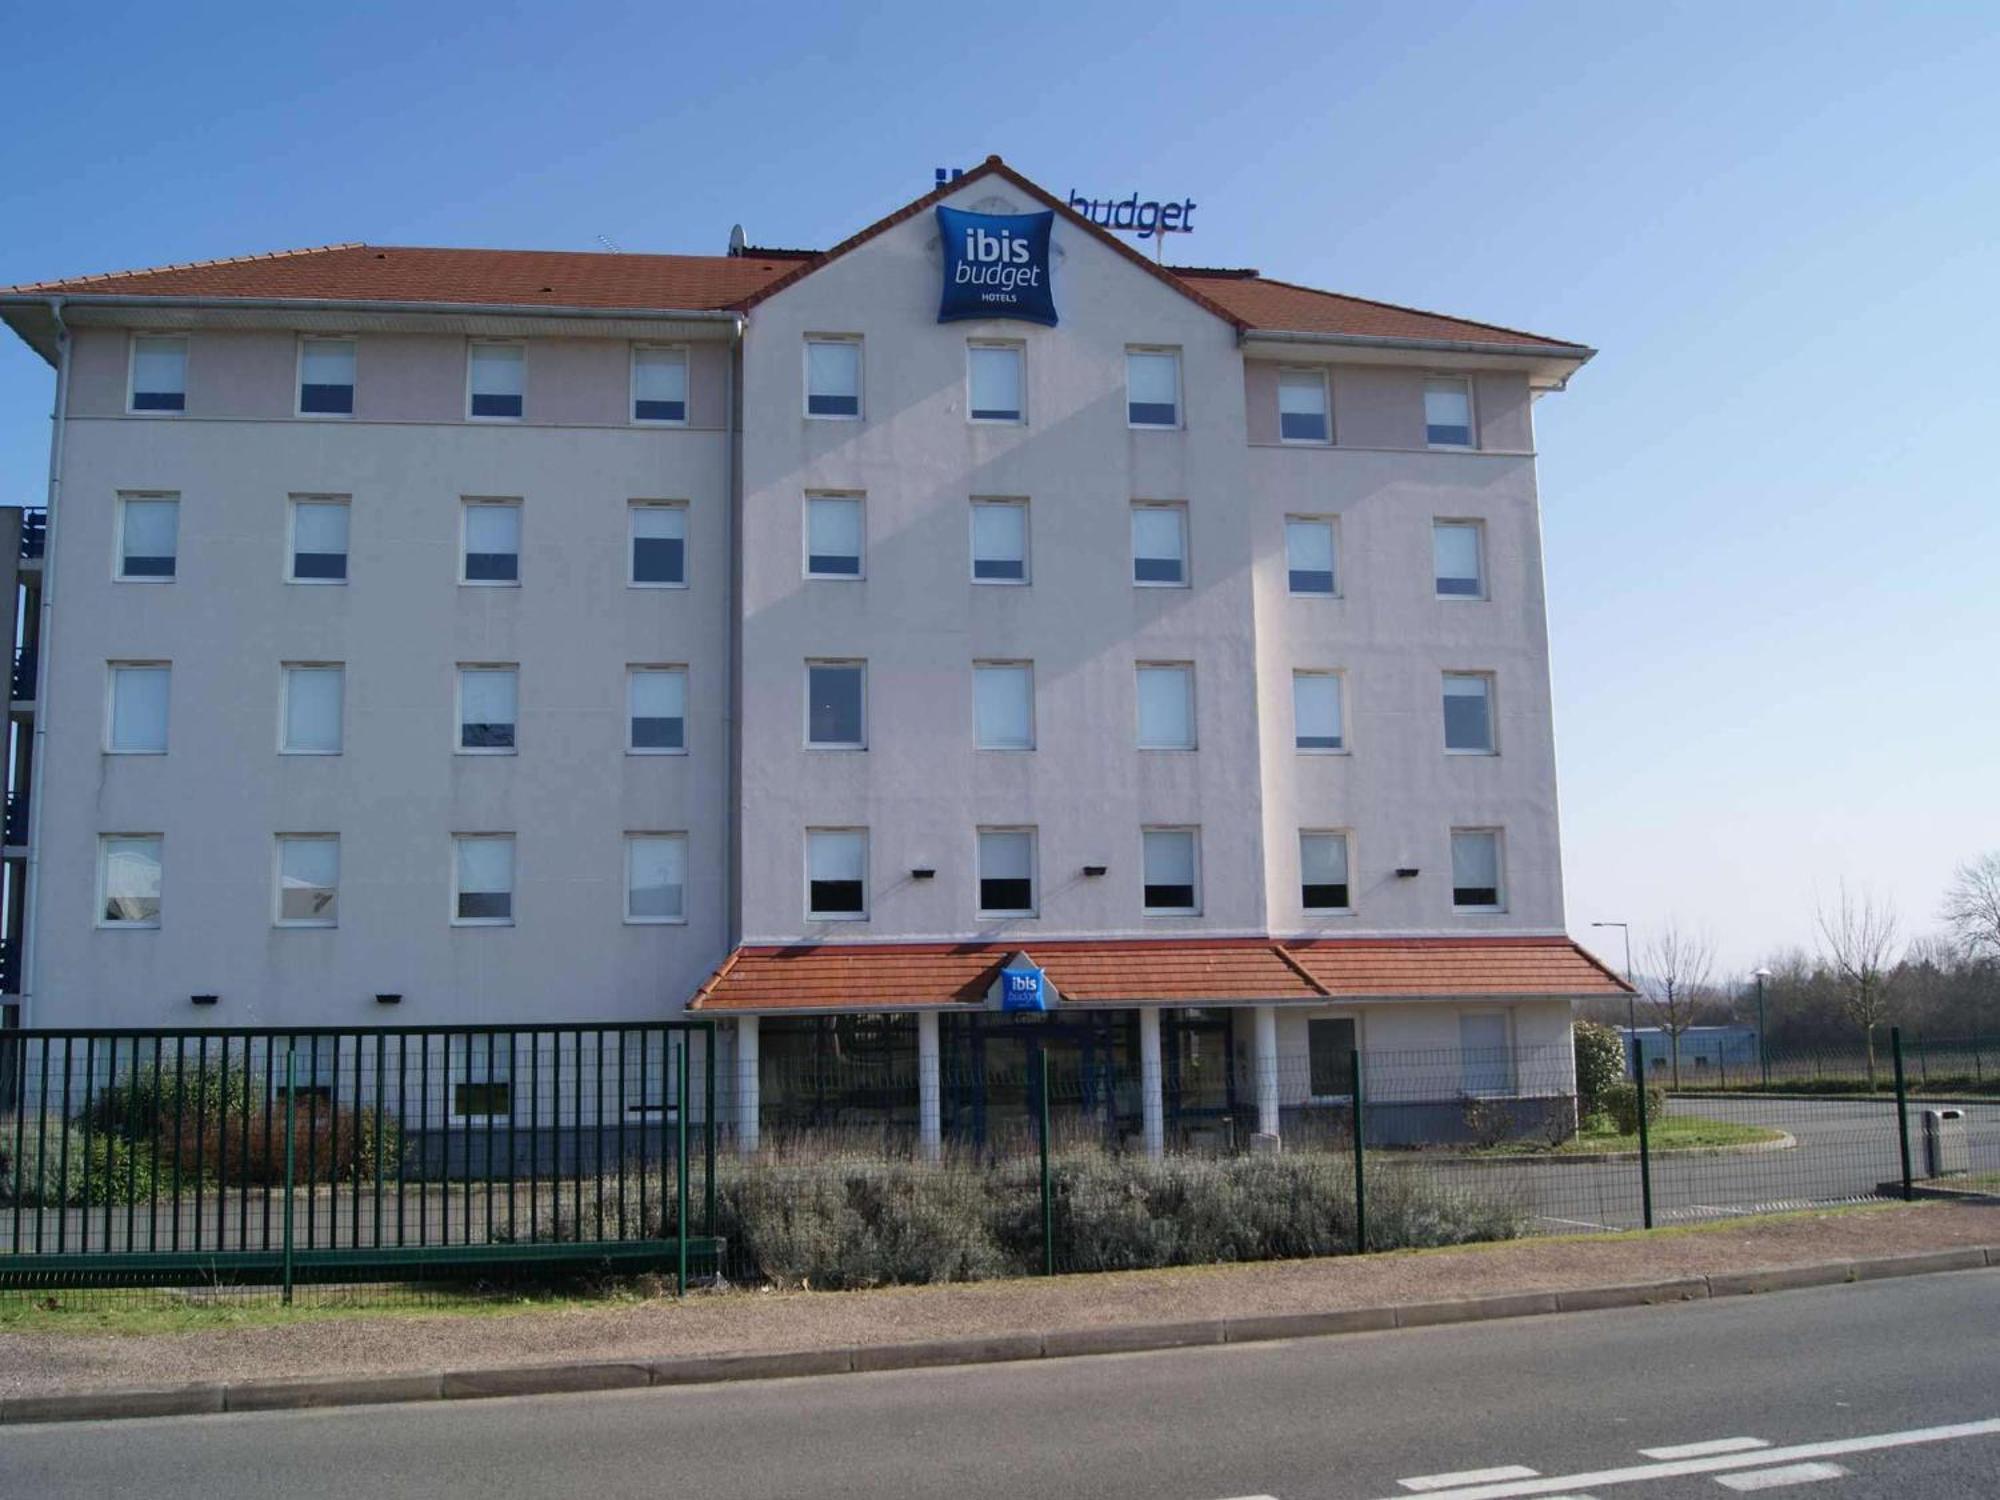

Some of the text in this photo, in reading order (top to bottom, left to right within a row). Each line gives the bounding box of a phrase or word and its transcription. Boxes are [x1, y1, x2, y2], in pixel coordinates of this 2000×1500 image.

[966, 228, 1030, 264] ibis
[955, 259, 1041, 292] budget
[981, 293, 1017, 303] HOTELS
[1012, 976, 1037, 991] ibis
